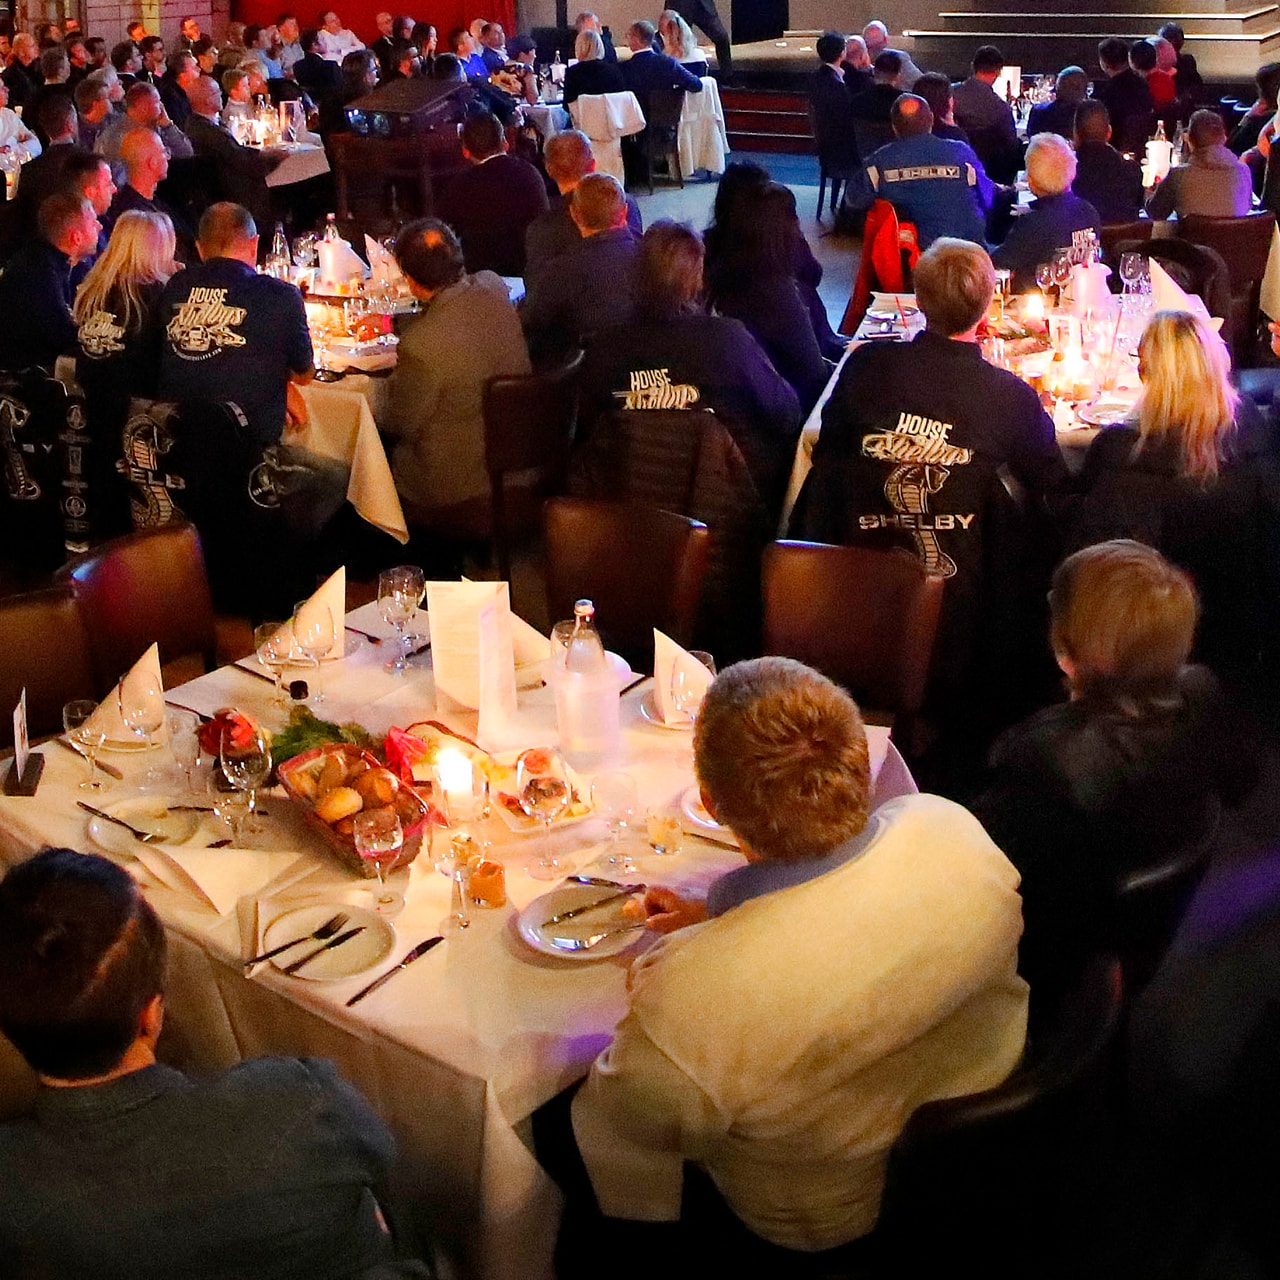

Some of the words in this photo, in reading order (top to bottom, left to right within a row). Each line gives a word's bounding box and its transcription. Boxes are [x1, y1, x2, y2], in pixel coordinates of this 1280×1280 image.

[188, 287, 228, 305] HOUSE
[630, 368, 671, 392] HOUSE
[896, 412, 953, 440] HOUSE
[859, 514, 975, 530] SHELBY
